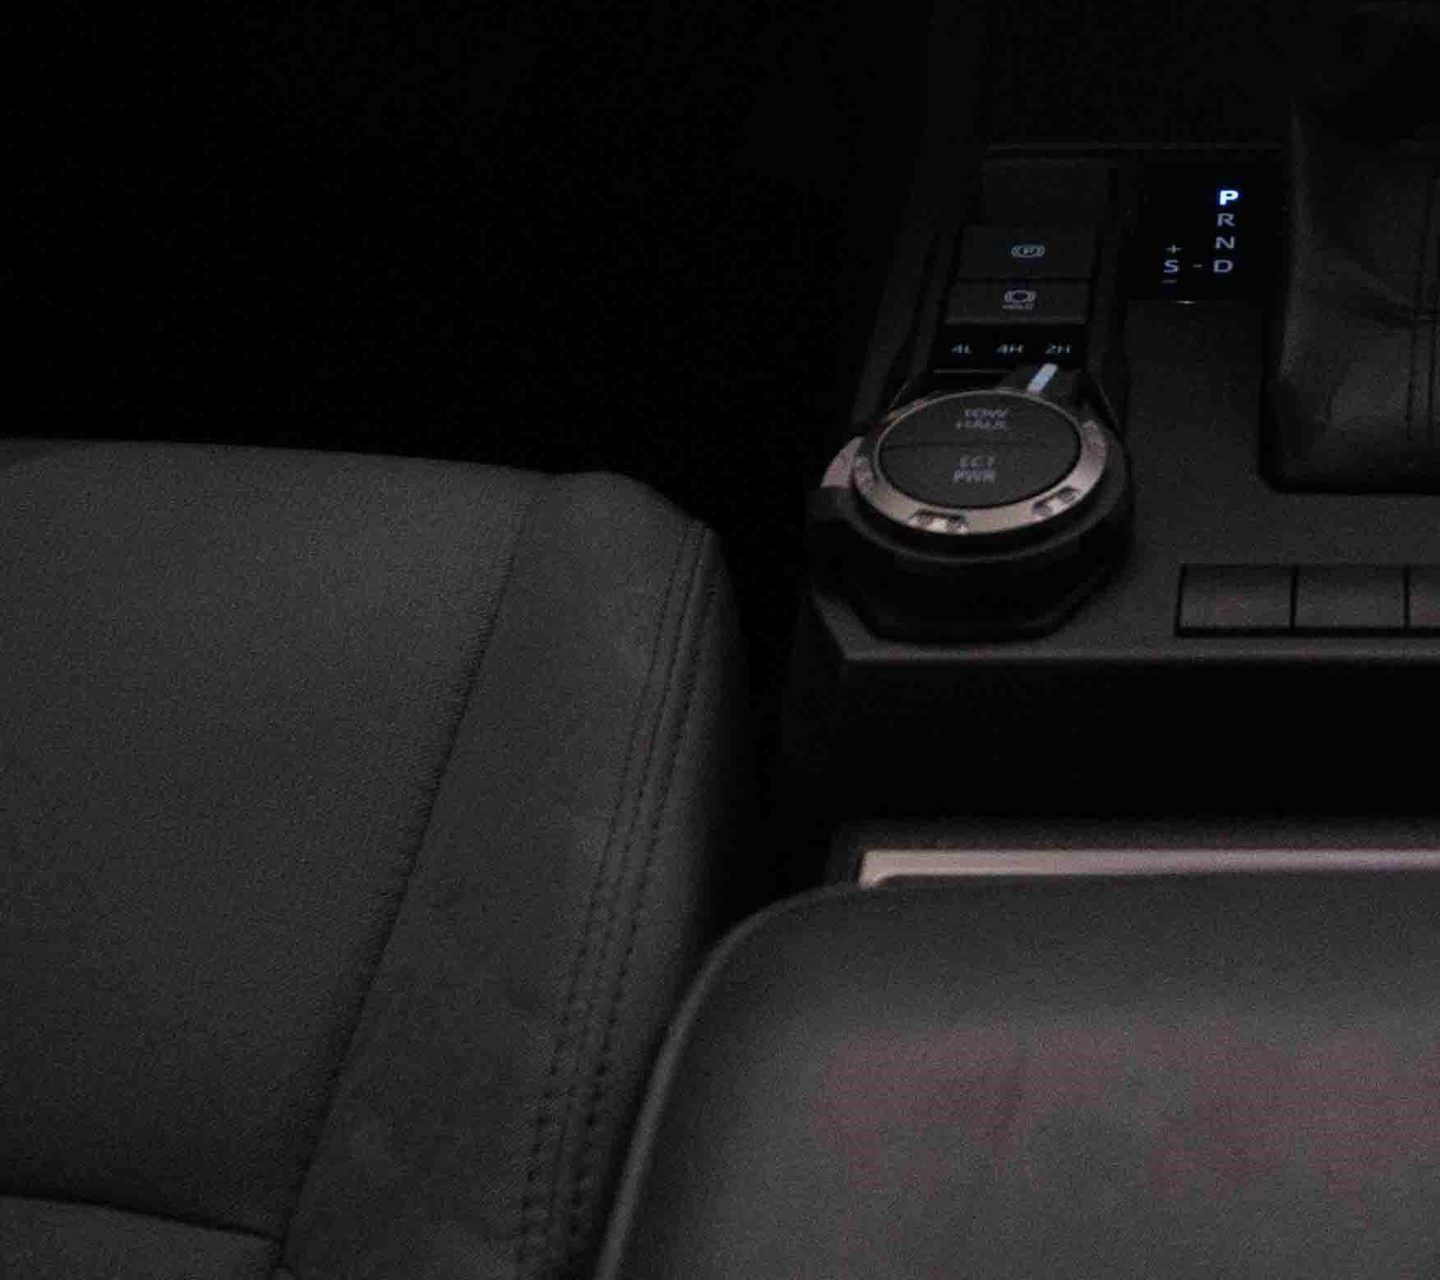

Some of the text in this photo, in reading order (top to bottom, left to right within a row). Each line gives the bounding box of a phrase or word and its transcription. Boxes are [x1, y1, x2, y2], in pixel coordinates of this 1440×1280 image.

[1219, 189, 1239, 206] P
[1216, 212, 1236, 227] R
[1215, 235, 1235, 250] N
[1163, 259, 1179, 273] S
[1213, 259, 1234, 273] D
[951, 343, 1071, 355] 4L 4H 2H
